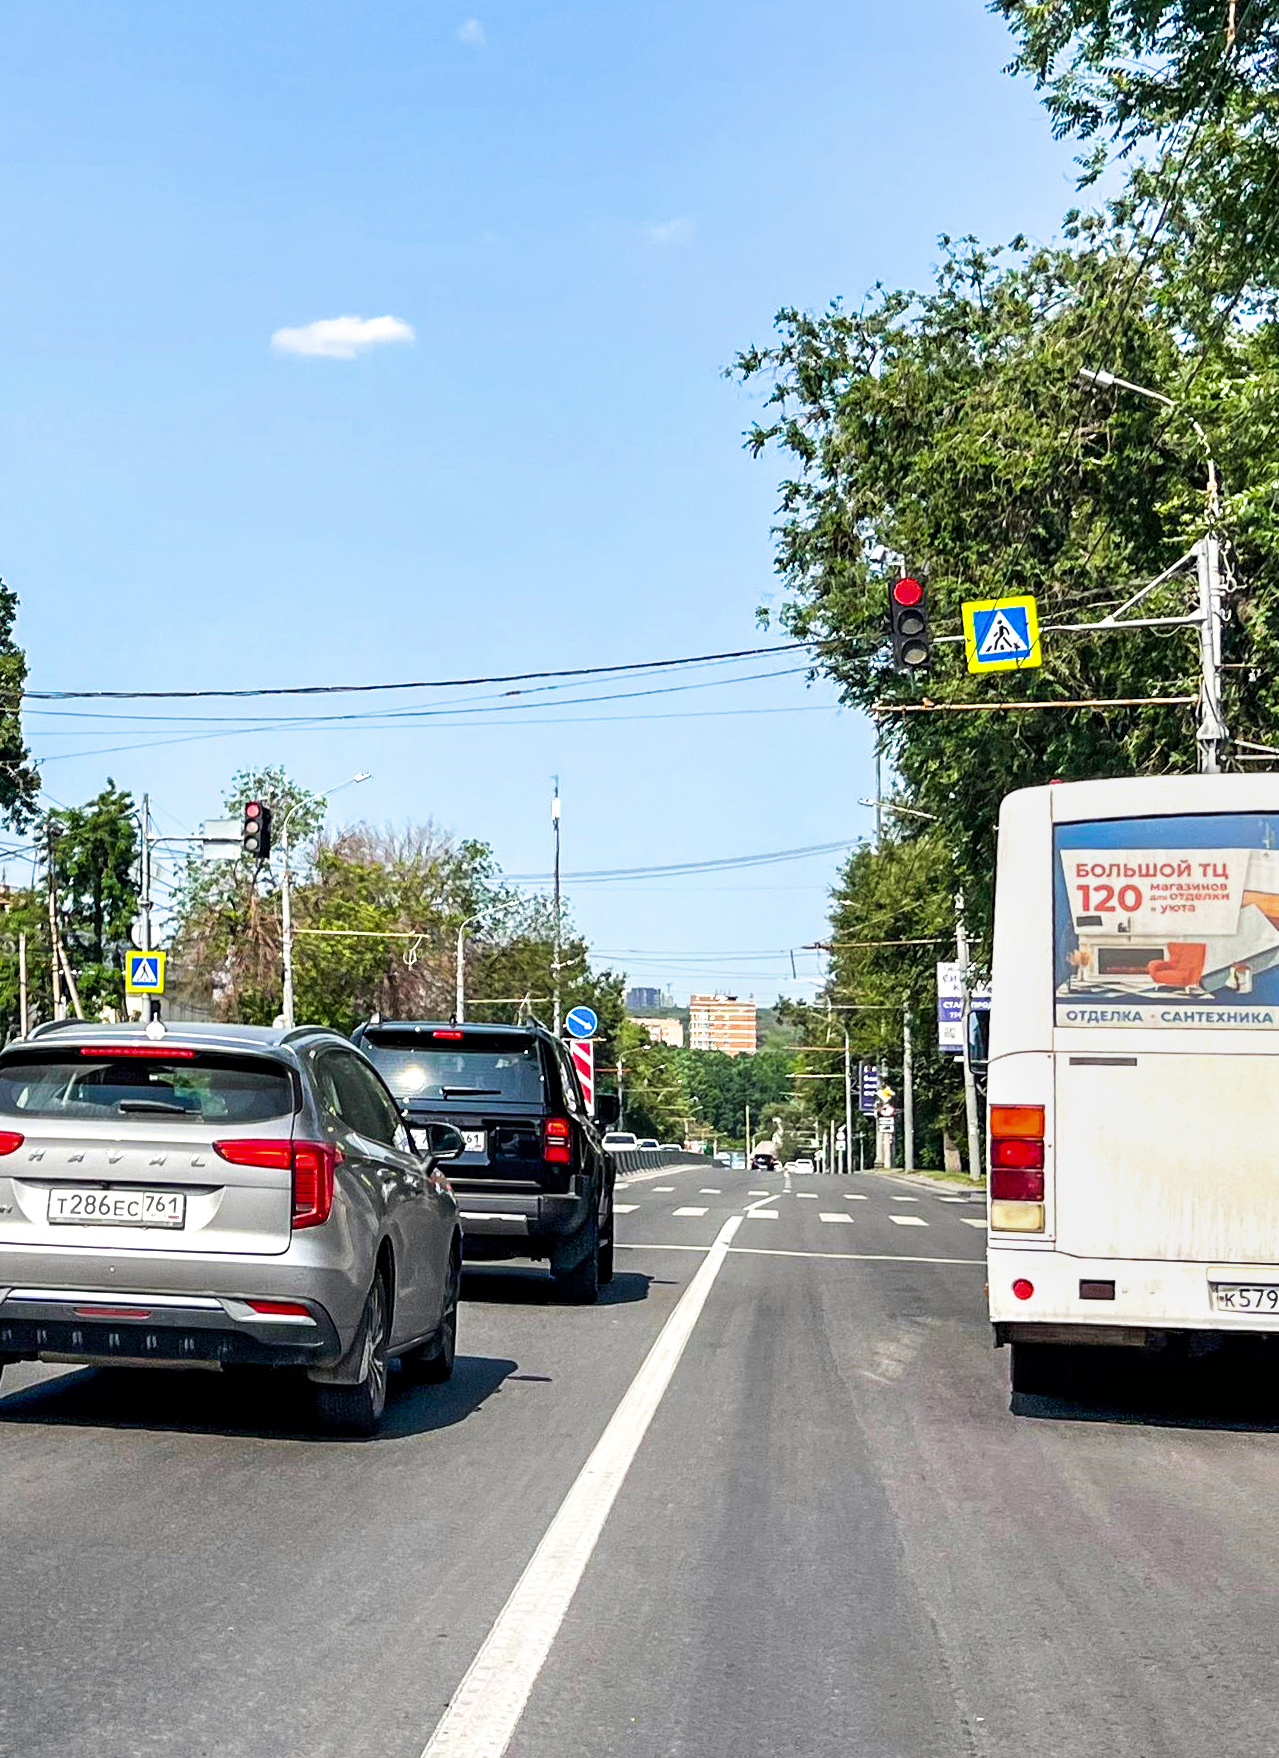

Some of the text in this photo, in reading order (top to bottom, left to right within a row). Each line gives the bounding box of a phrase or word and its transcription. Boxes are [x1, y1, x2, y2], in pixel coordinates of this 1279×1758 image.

[1075, 860, 1229, 880] БОЛЬШОЙ ТЦ
[1150, 883, 1228, 892] магазинов
[1076, 884, 1143, 913] 120
[1169, 892, 1230, 902] отделки
[1160, 904, 1196, 915] уюта
[1065, 1010, 1274, 1024] ОТДЕЛКА САНТЕХНИКА
[28, 1147, 207, 1168] HAVAL
[145, 1195, 178, 1214] 761
